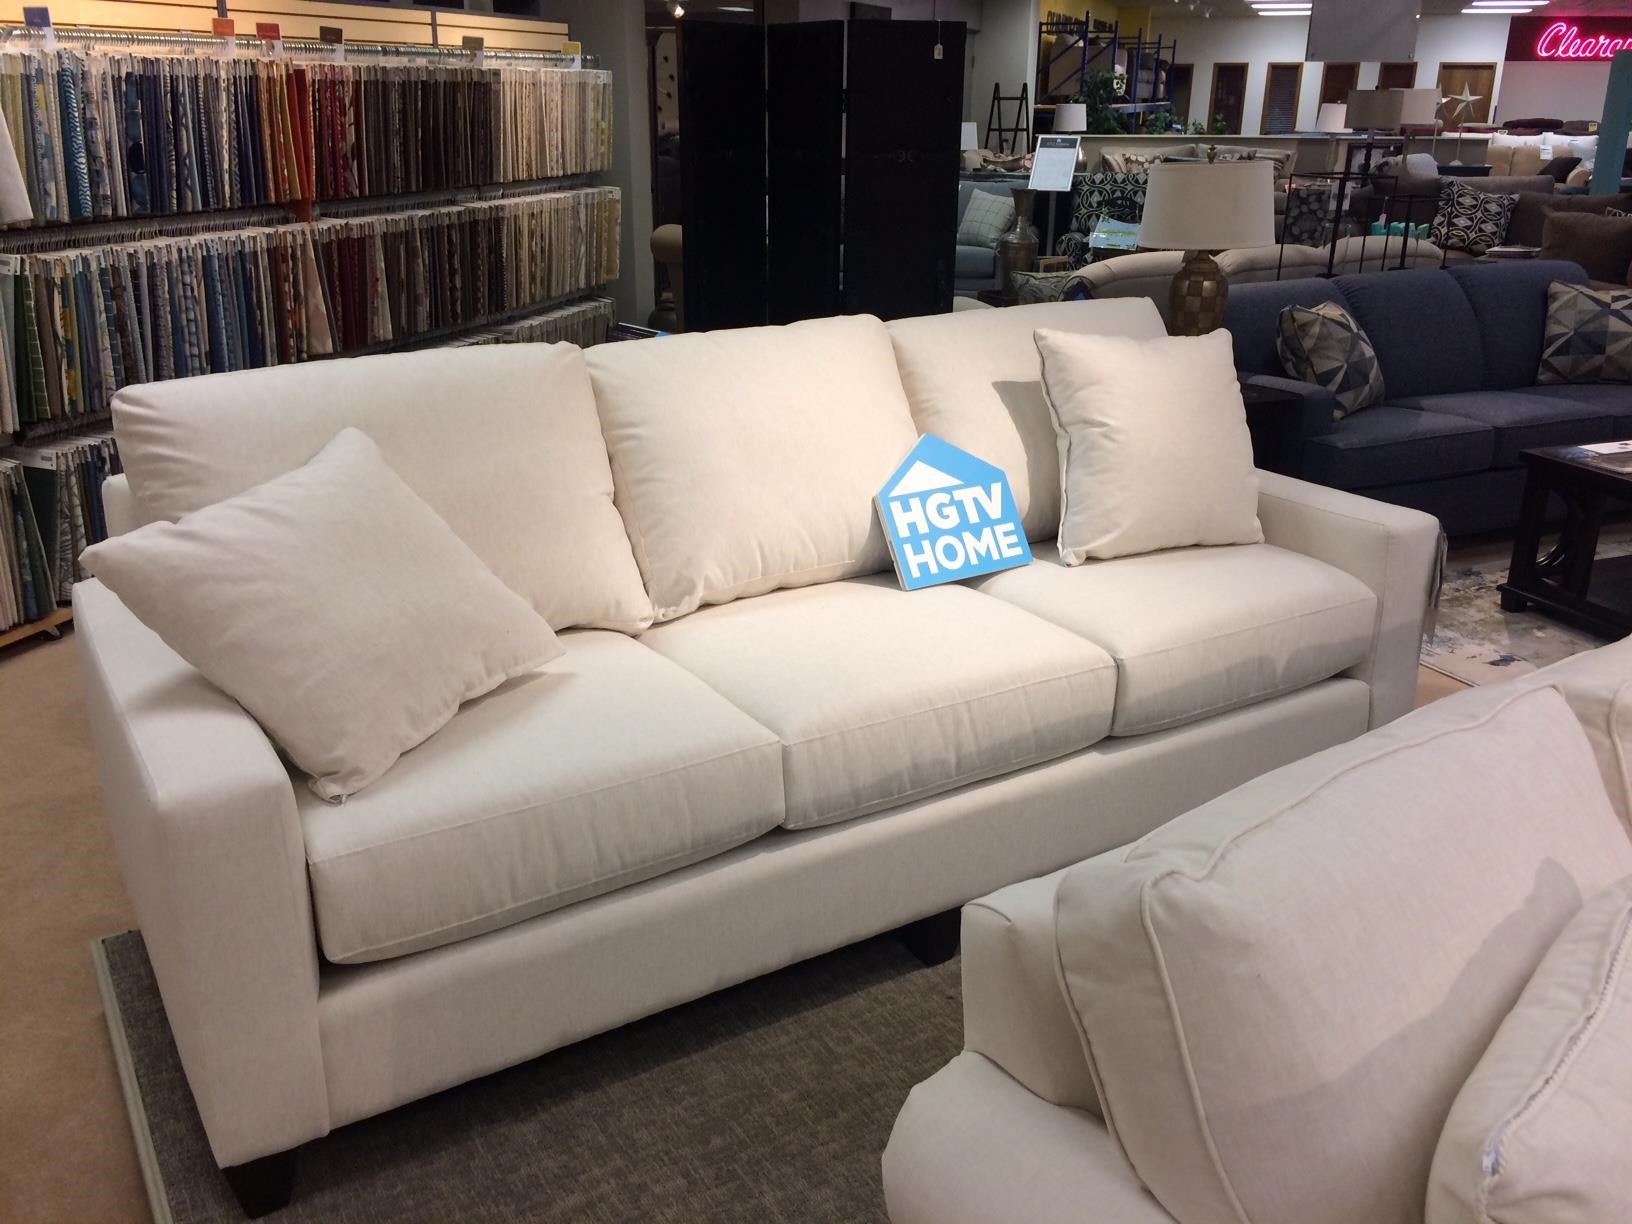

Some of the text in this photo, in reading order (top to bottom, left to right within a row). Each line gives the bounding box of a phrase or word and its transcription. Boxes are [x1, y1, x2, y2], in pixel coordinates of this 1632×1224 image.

[1537, 22, 1632, 57] Cleara
[889, 482, 1001, 538] HGTV
[903, 522, 1023, 578] HOME
